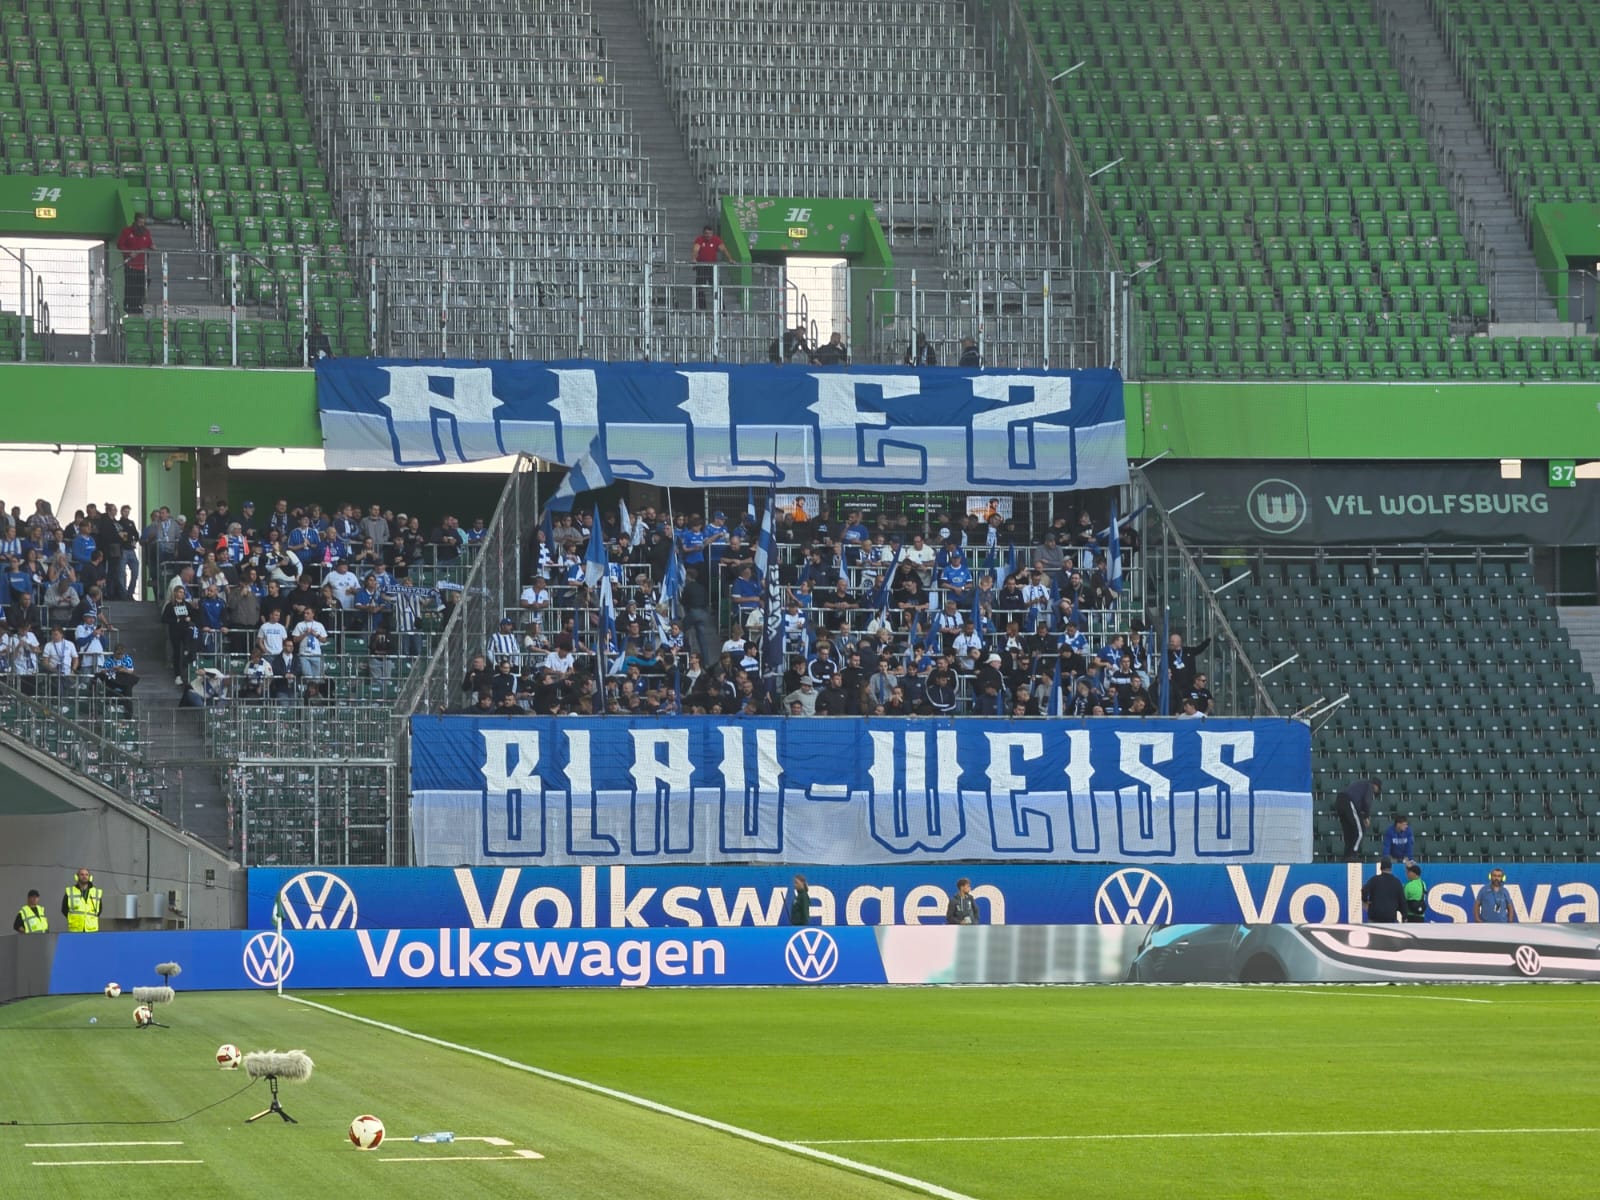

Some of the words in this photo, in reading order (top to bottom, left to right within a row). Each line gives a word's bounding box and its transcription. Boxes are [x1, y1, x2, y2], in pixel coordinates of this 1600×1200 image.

[32, 186, 62, 202] 34
[783, 207, 812, 222] 36
[98, 452, 121, 468] 33
[1551, 465, 1574, 481] 37
[1325, 495, 1373, 515] VfL
[1379, 493, 1549, 515] WOLFSBURG
[357, 928, 725, 987] Volkswagen
